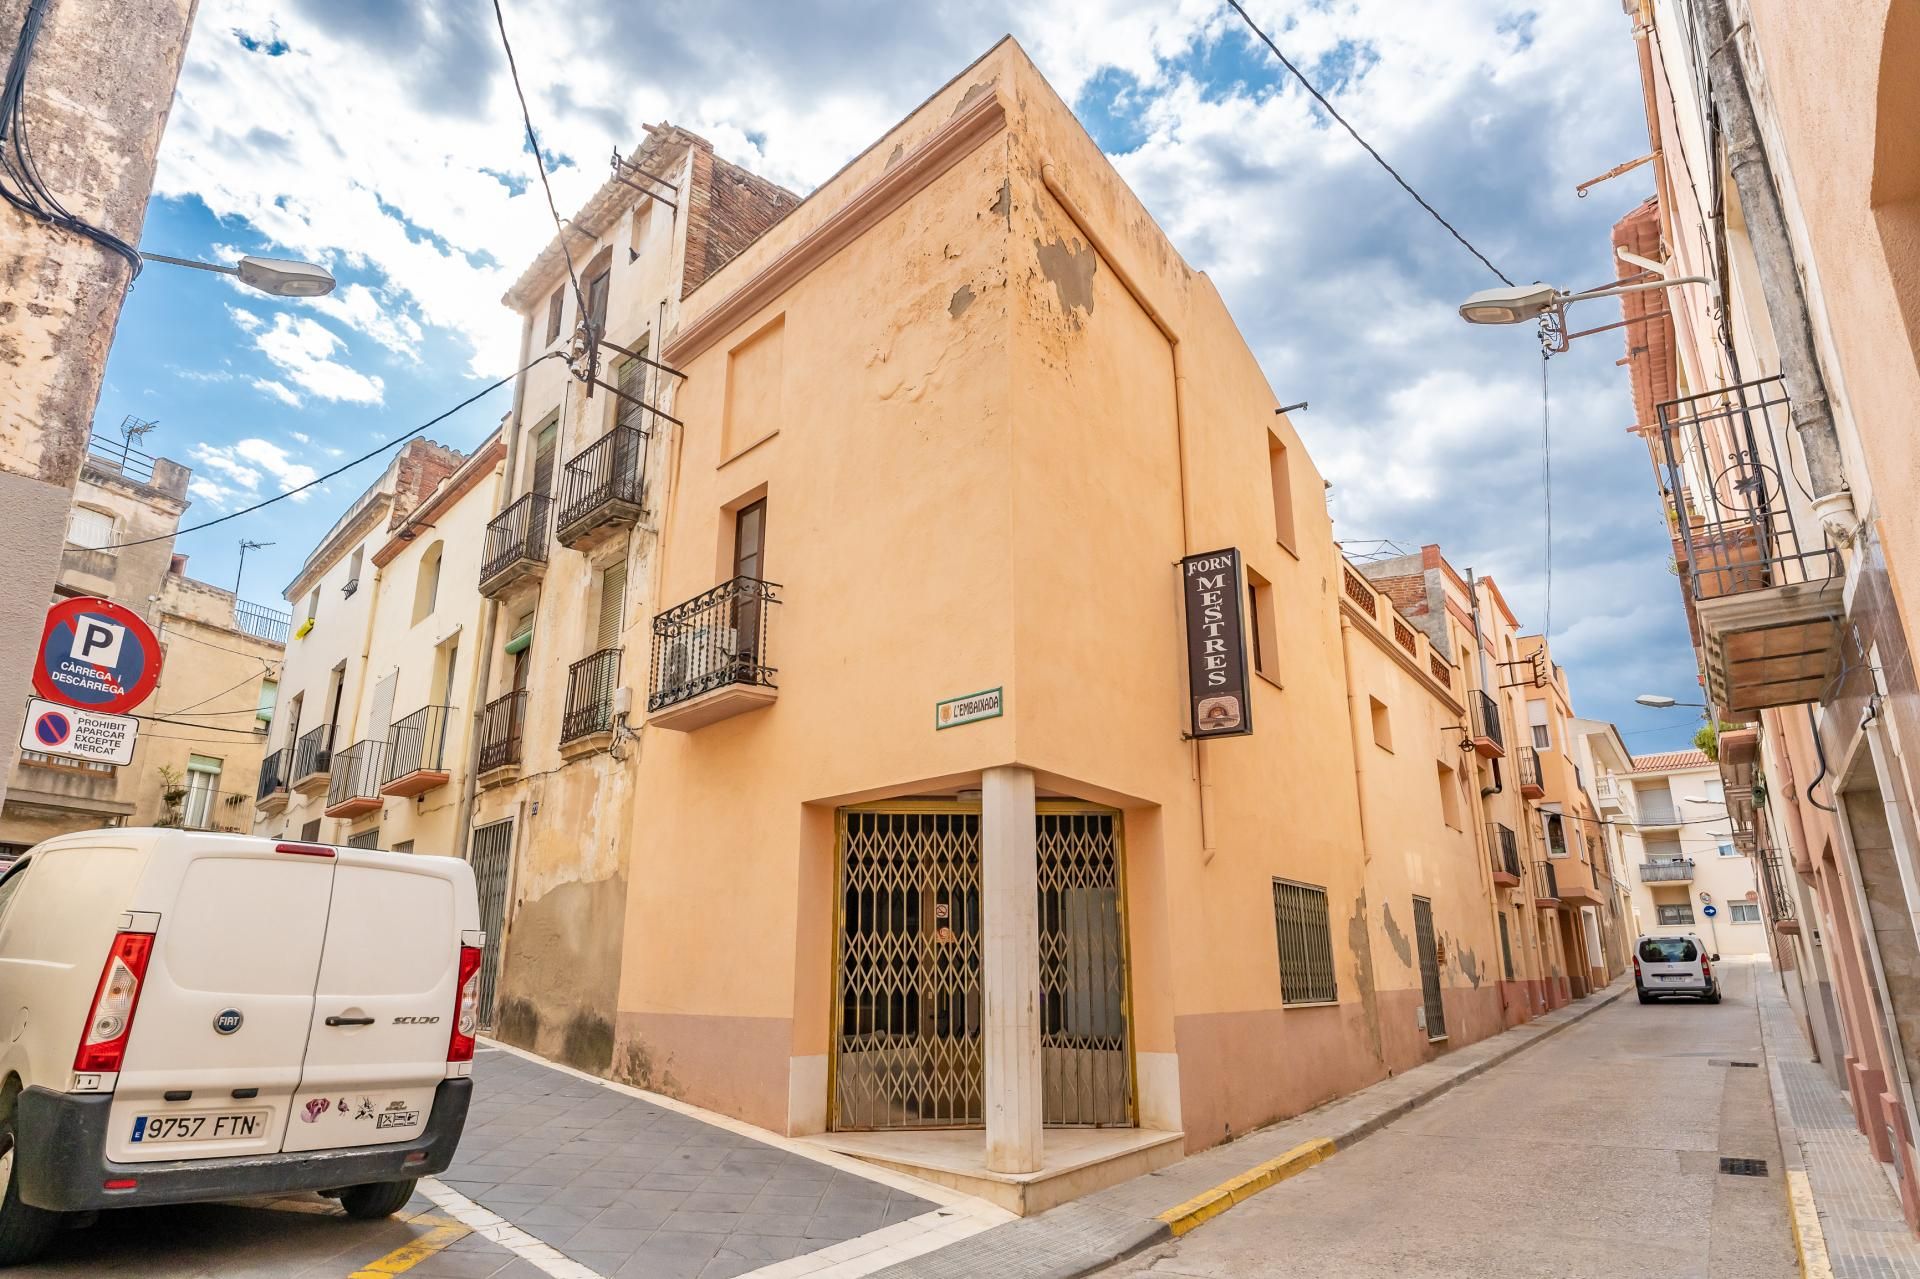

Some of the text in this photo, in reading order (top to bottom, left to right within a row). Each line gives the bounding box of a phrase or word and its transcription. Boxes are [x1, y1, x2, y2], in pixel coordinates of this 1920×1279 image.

[1187, 555, 1232, 576] FORN
[82, 623, 114, 657] P
[1196, 573, 1228, 687] MESTRES
[61, 662, 112, 682] CÀRREGA
[52, 671, 125, 695] DESCÀRREGA
[953, 695, 999, 718] L'EMBAIXADA
[76, 726, 125, 739] APARCAR
[78, 718, 127, 731] PROHIBIT
[73, 742, 116, 755] MERCAT
[75, 734, 122, 748] EXCEPTE
[218, 1016, 240, 1026] FIAT
[392, 1016, 440, 1025] SCUDO
[148, 1115, 256, 1139] 9757 FTN
